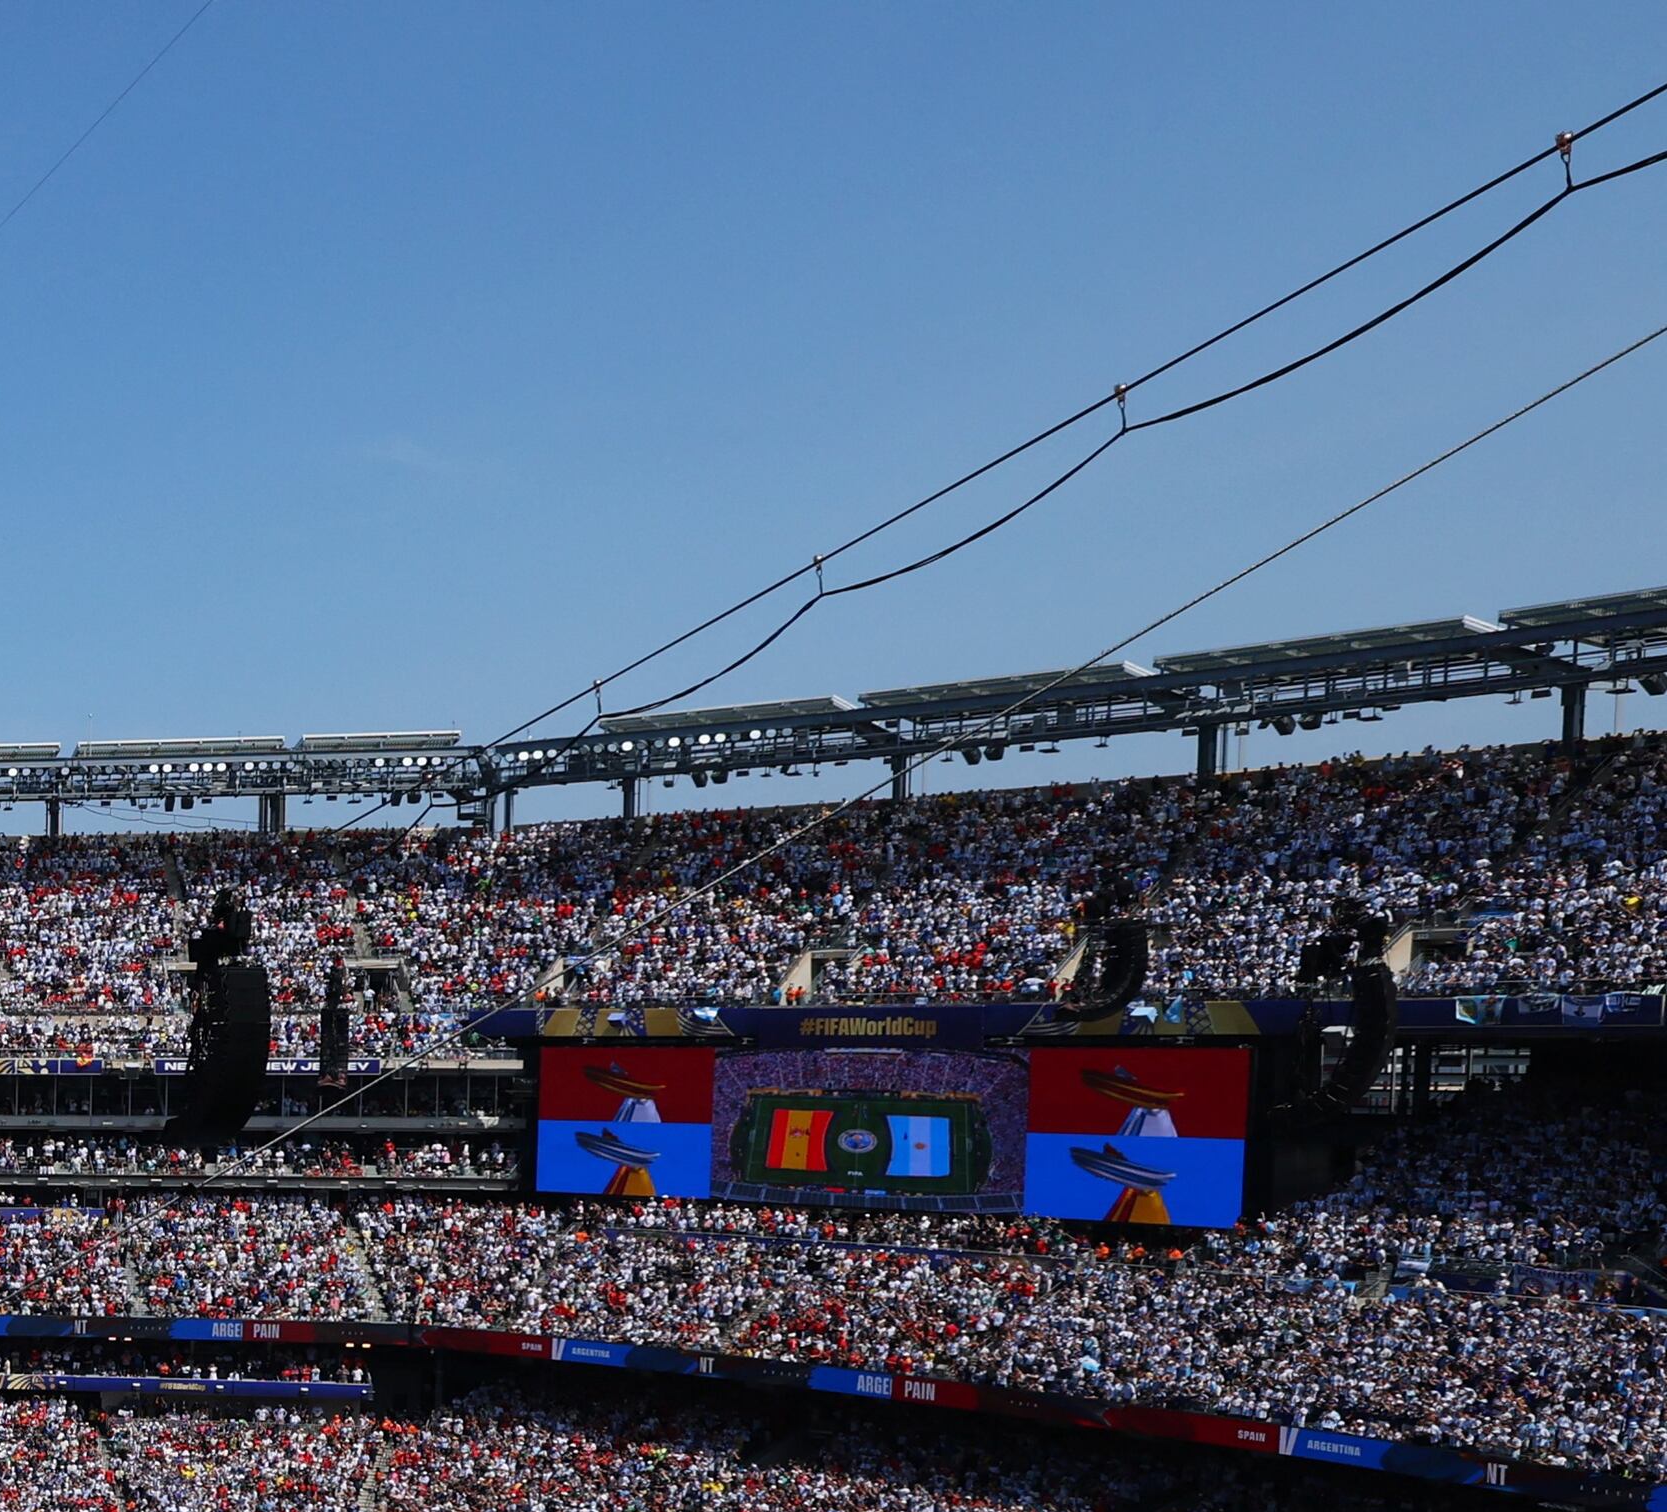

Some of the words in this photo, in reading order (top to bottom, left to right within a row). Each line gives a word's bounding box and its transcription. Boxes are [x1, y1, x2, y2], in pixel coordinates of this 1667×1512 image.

[800, 1016, 937, 1039] #FIFAWorldCup
[521, 1342, 543, 1352] SPAIN
[572, 1346, 610, 1359] ARGENTINA
[1237, 1428, 1266, 1443] SPAIN
[1307, 1439, 1361, 1457] ARGENTINA
